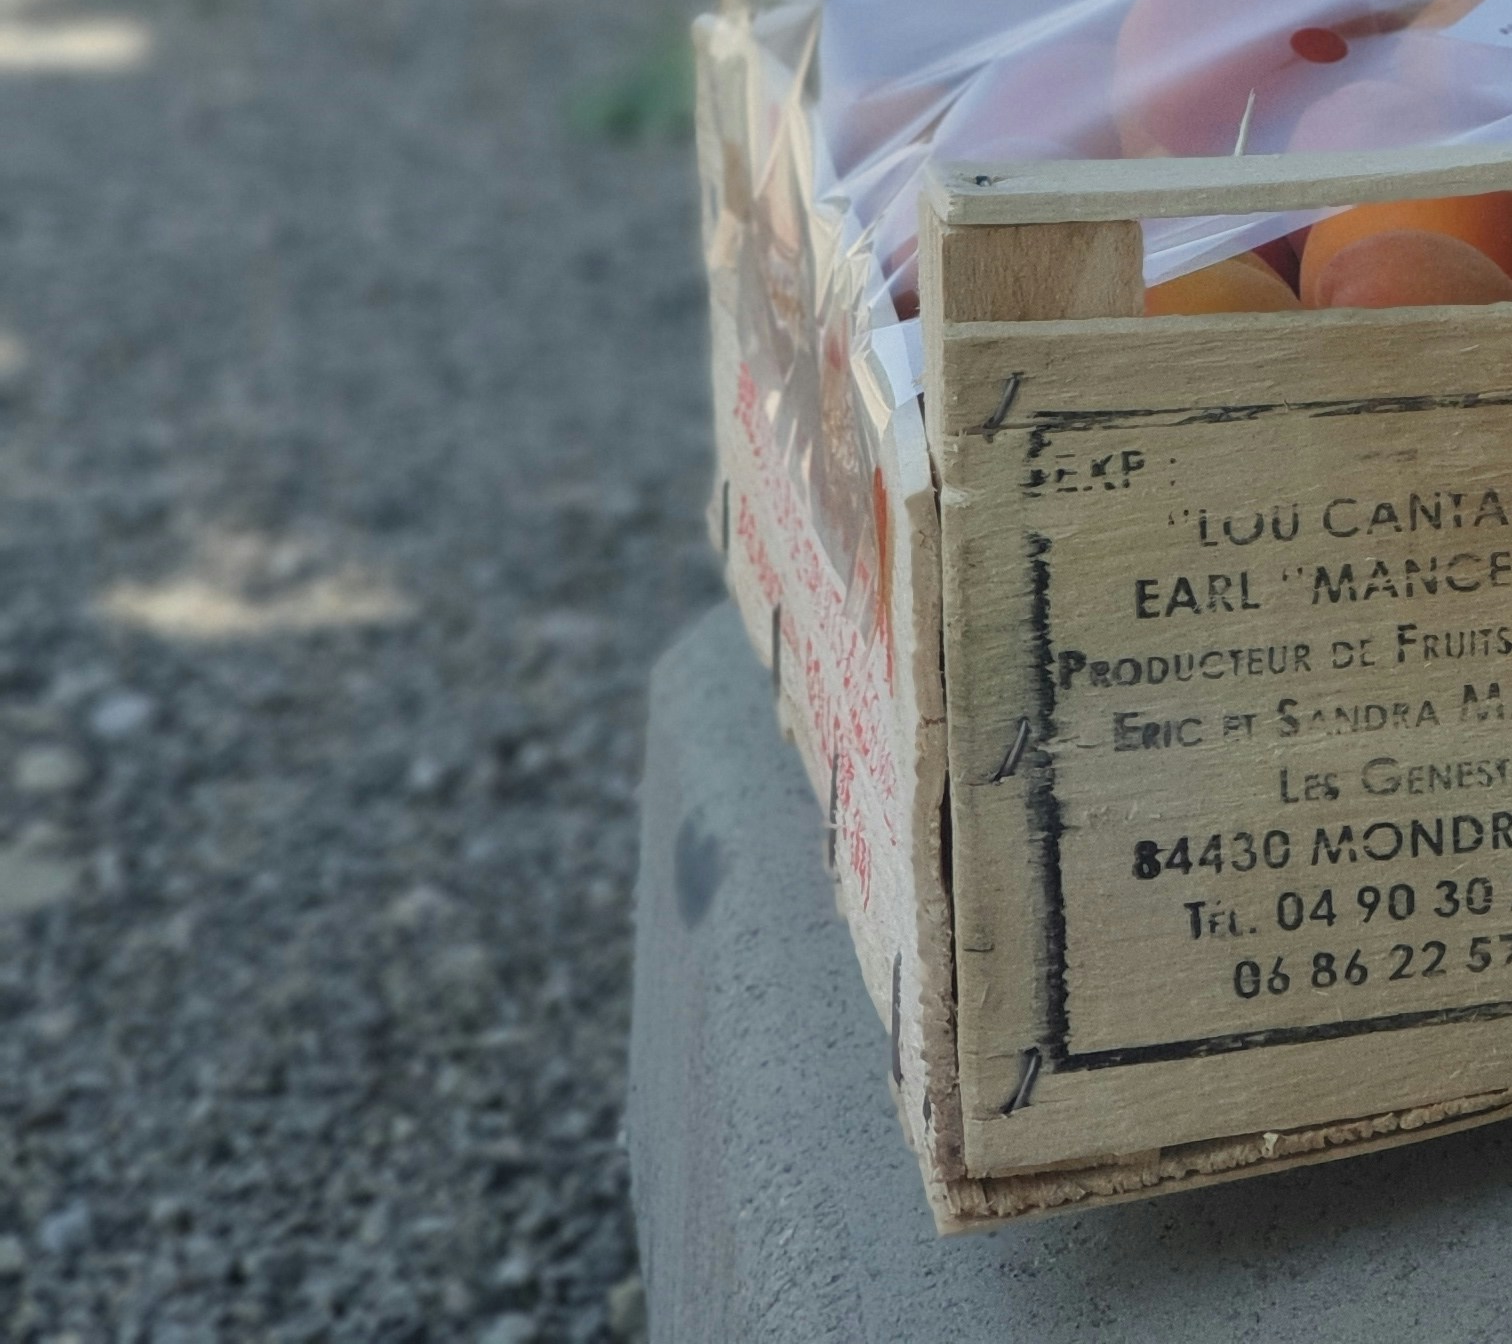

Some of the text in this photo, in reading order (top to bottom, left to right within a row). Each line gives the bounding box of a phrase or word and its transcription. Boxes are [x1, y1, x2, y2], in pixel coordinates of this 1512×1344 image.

[1135, 571, 1262, 620] EARL
[1132, 830, 1291, 881] 84430
[1276, 888, 1338, 931] 04
[1356, 883, 1416, 924] 90
[1433, 877, 1494, 918] 30
[1232, 956, 1291, 1000] 06
[1310, 948, 1369, 989] 86
[1388, 940, 1448, 982] 22
